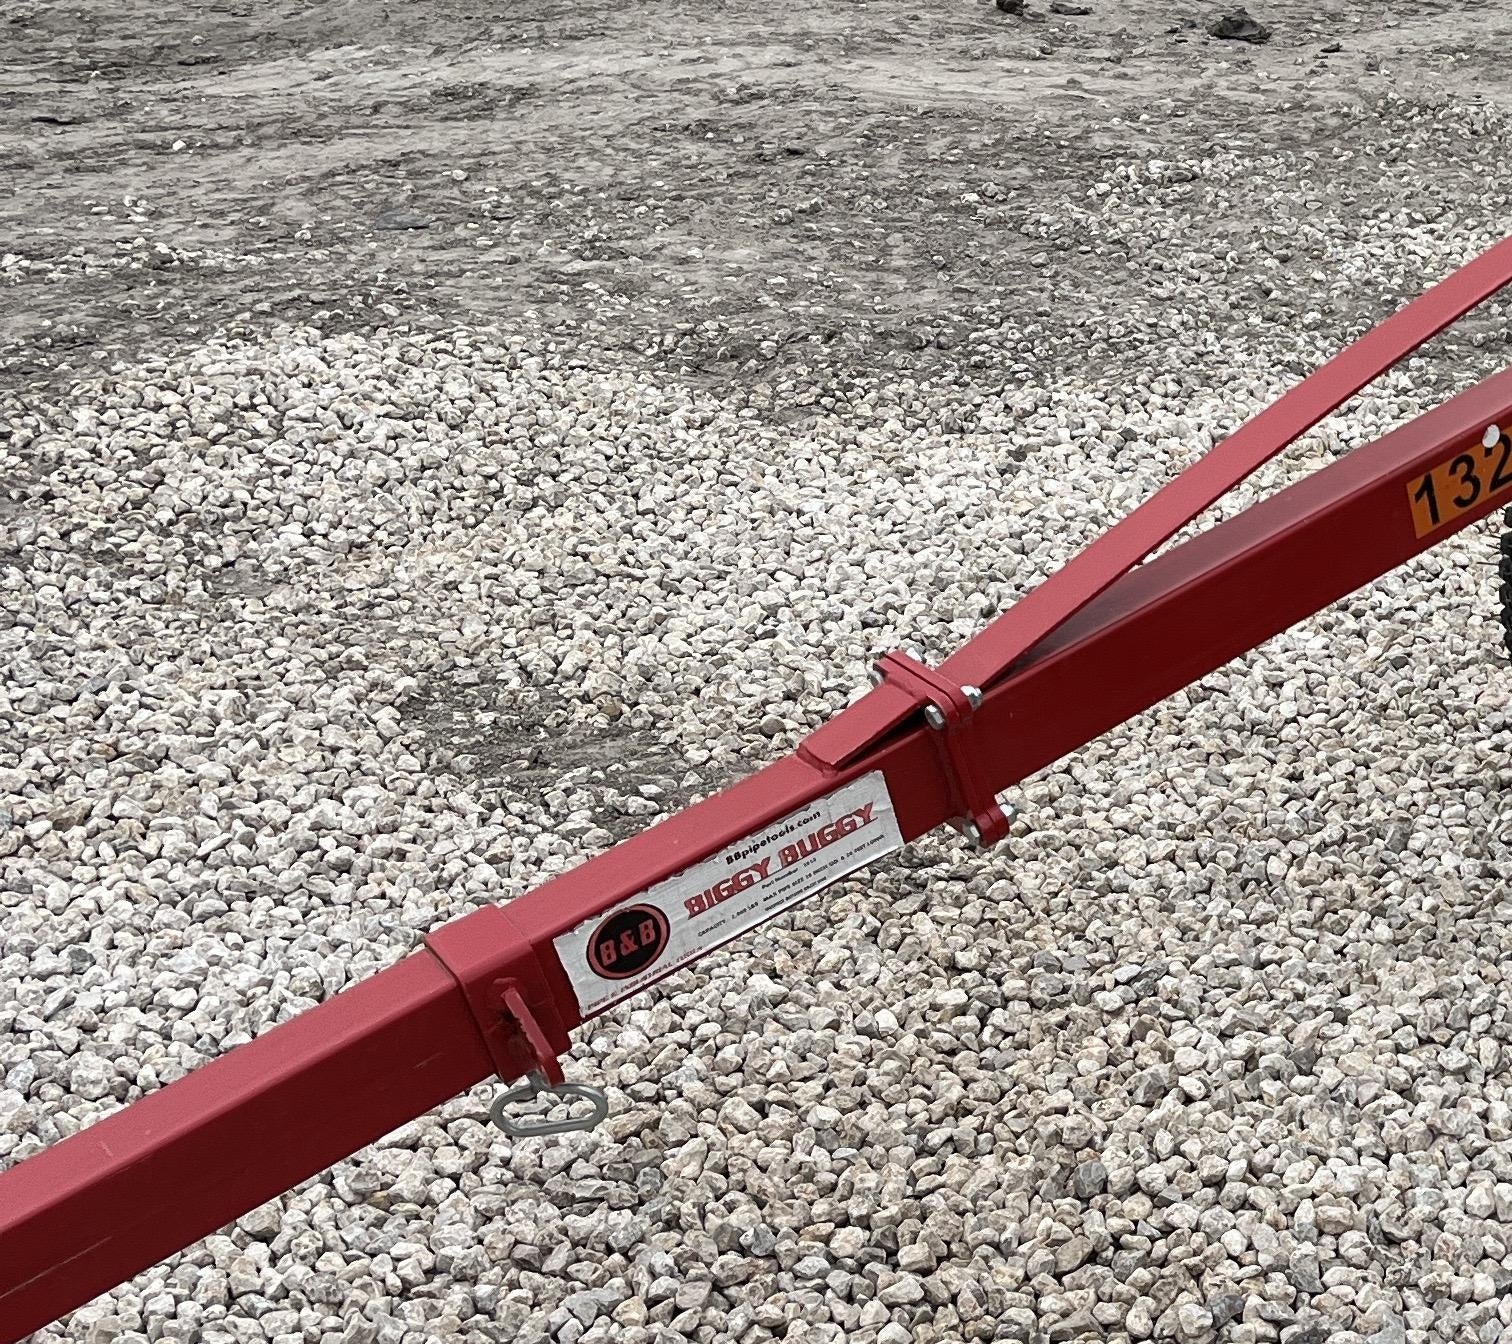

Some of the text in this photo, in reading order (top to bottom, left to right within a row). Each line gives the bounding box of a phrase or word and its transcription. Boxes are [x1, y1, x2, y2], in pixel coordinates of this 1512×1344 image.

[684, 856, 771, 918] BIGGY
[778, 802, 876, 868] BUGGY
[600, 919, 656, 967] B&B
